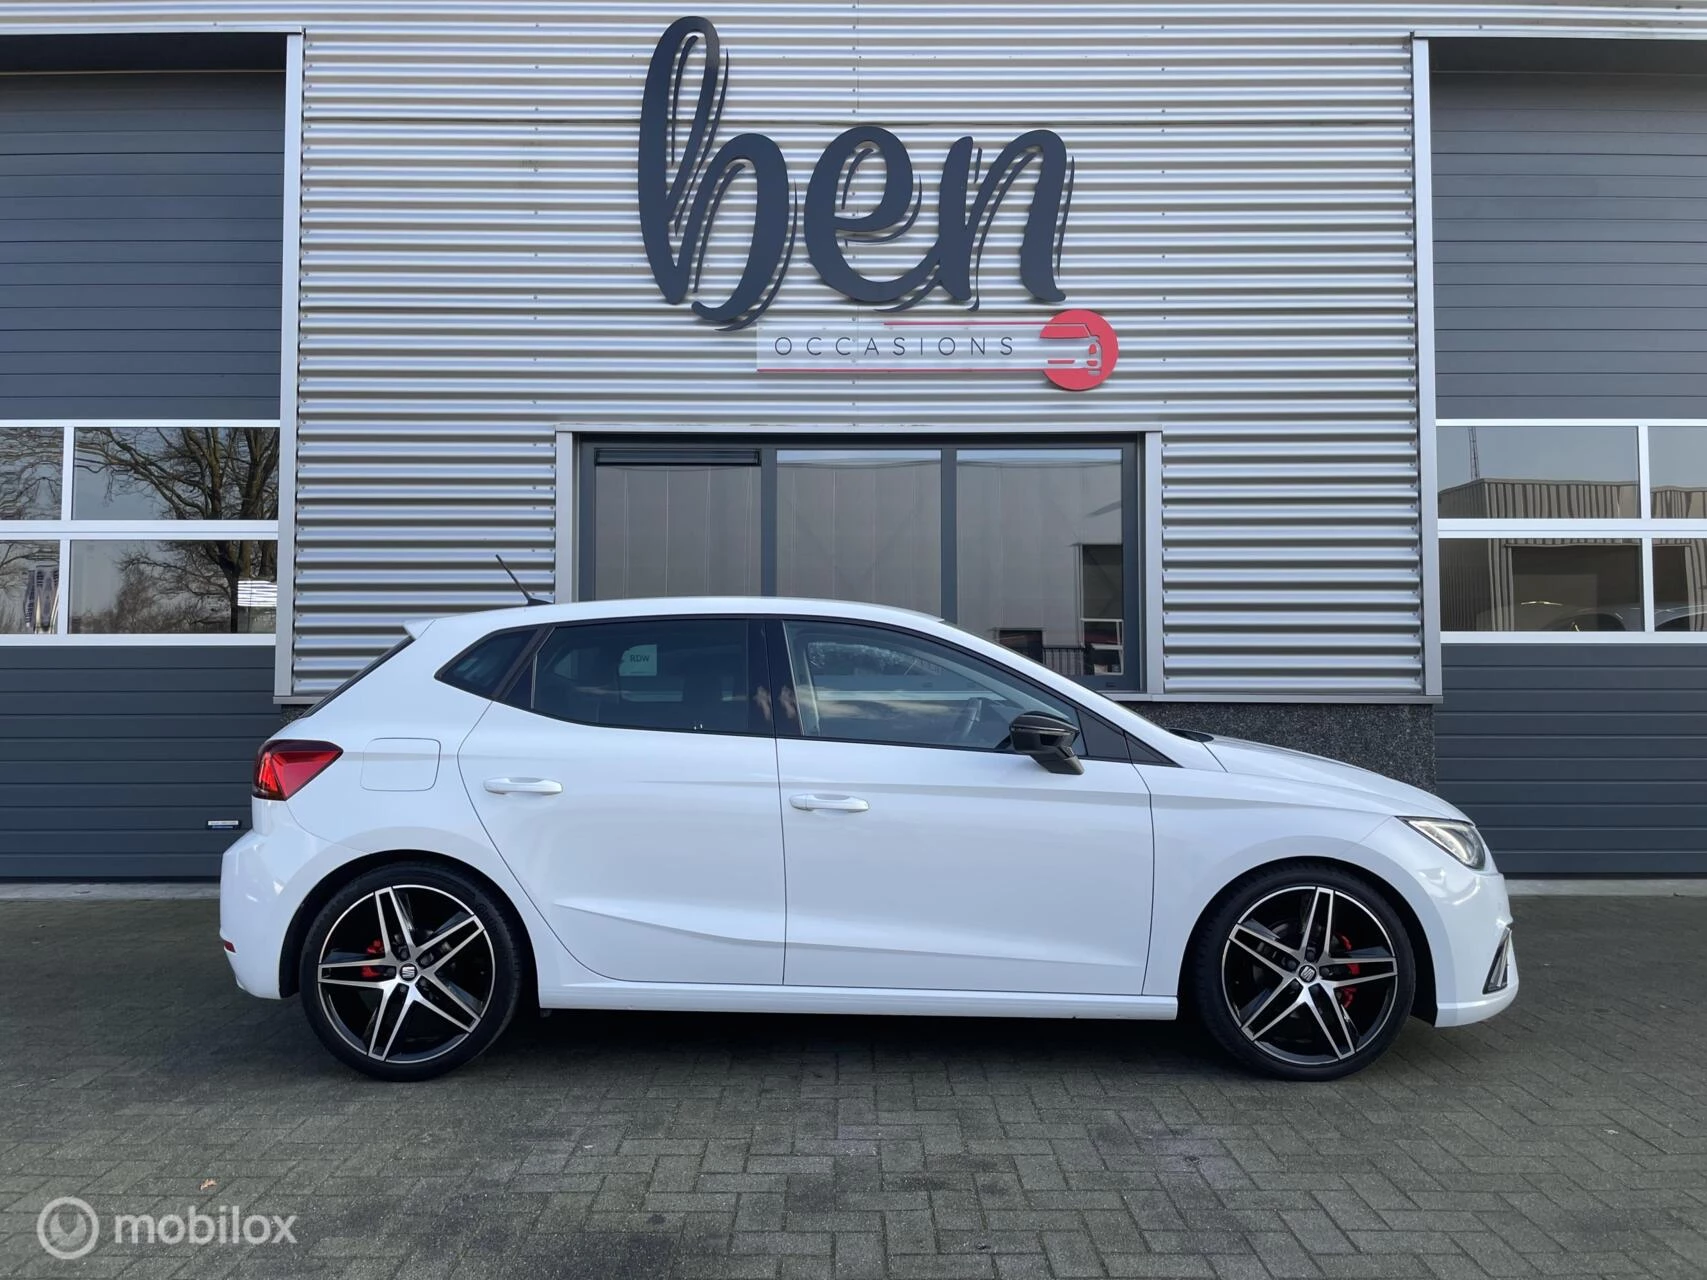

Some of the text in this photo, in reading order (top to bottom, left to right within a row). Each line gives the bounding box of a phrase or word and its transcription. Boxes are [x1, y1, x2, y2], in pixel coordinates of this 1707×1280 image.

[638, 16, 1071, 326] ben
[773, 336, 1014, 357] OCCASIONS
[630, 655, 650, 663] RDW
